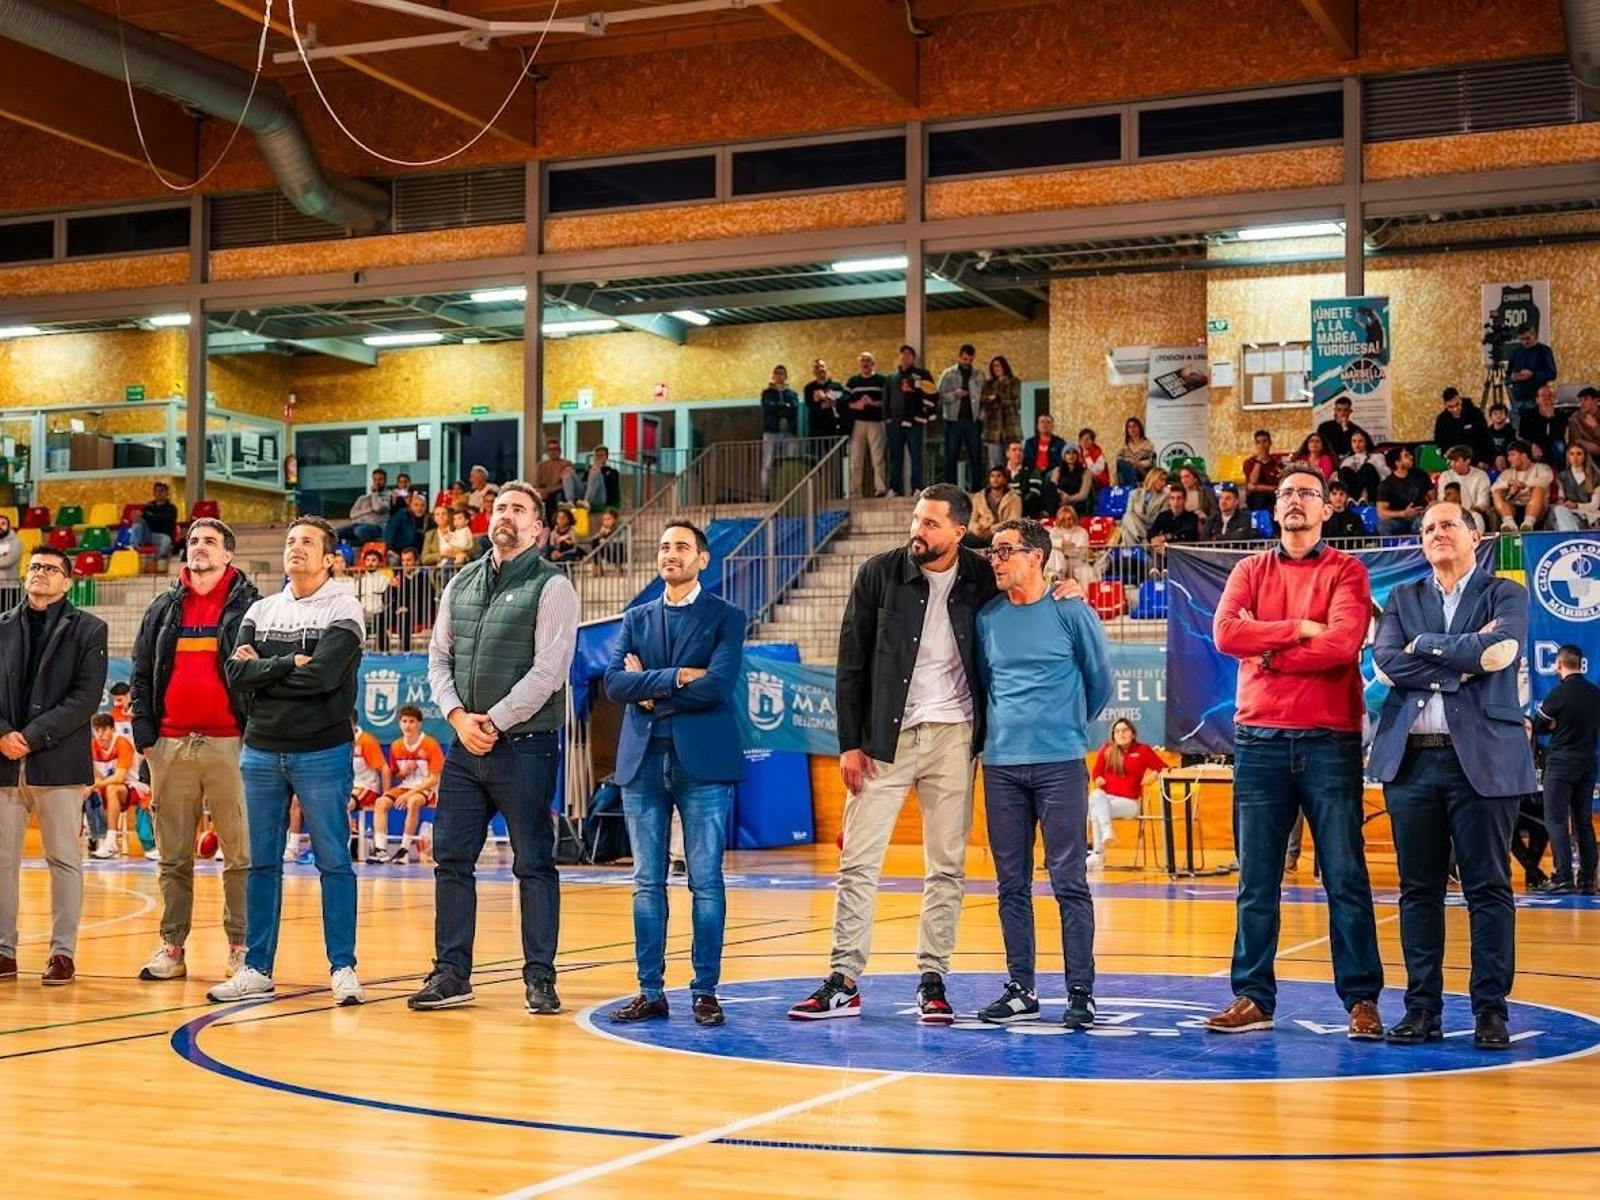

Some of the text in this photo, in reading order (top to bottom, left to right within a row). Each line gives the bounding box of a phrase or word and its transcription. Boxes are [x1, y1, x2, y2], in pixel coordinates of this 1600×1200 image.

[1313, 305, 1353, 323] ¡ÚNETE
[1316, 320, 1344, 332] A LA
[1316, 331, 1358, 344] MAREA
[1317, 341, 1380, 357] TURQUESA!
[1341, 368, 1386, 381] MARBELLA
[1559, 544, 1600, 557] BALO
[1539, 559, 1553, 593] CLUB
